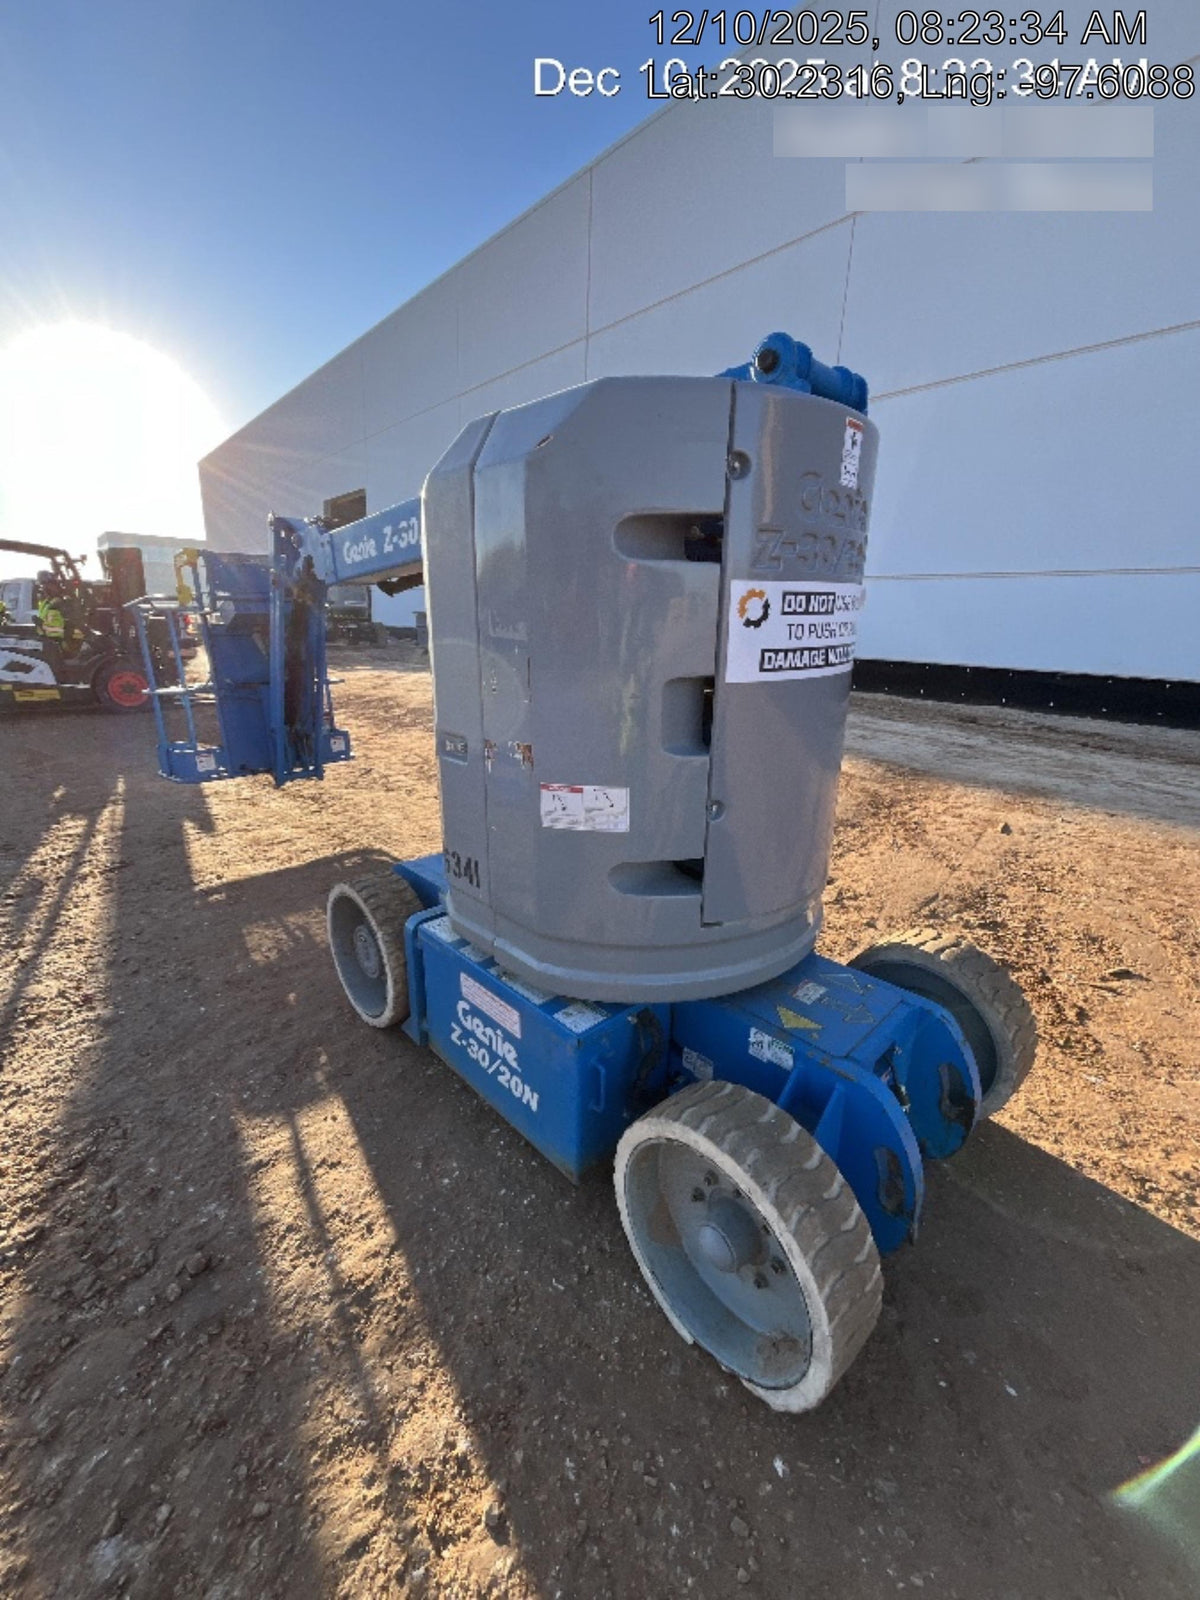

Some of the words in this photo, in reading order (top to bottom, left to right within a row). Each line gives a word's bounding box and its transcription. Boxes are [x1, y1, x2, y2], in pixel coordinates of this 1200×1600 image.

[343, 535, 377, 564] Genie
[783, 594, 806, 612] DO
[808, 594, 835, 612] NOT
[787, 622, 805, 641] TO
[808, 622, 837, 640] PUSH
[762, 650, 826, 669] DAMAGE
[456, 1000, 522, 1073] Genie
[450, 1021, 540, 1113] Z-30/20N
